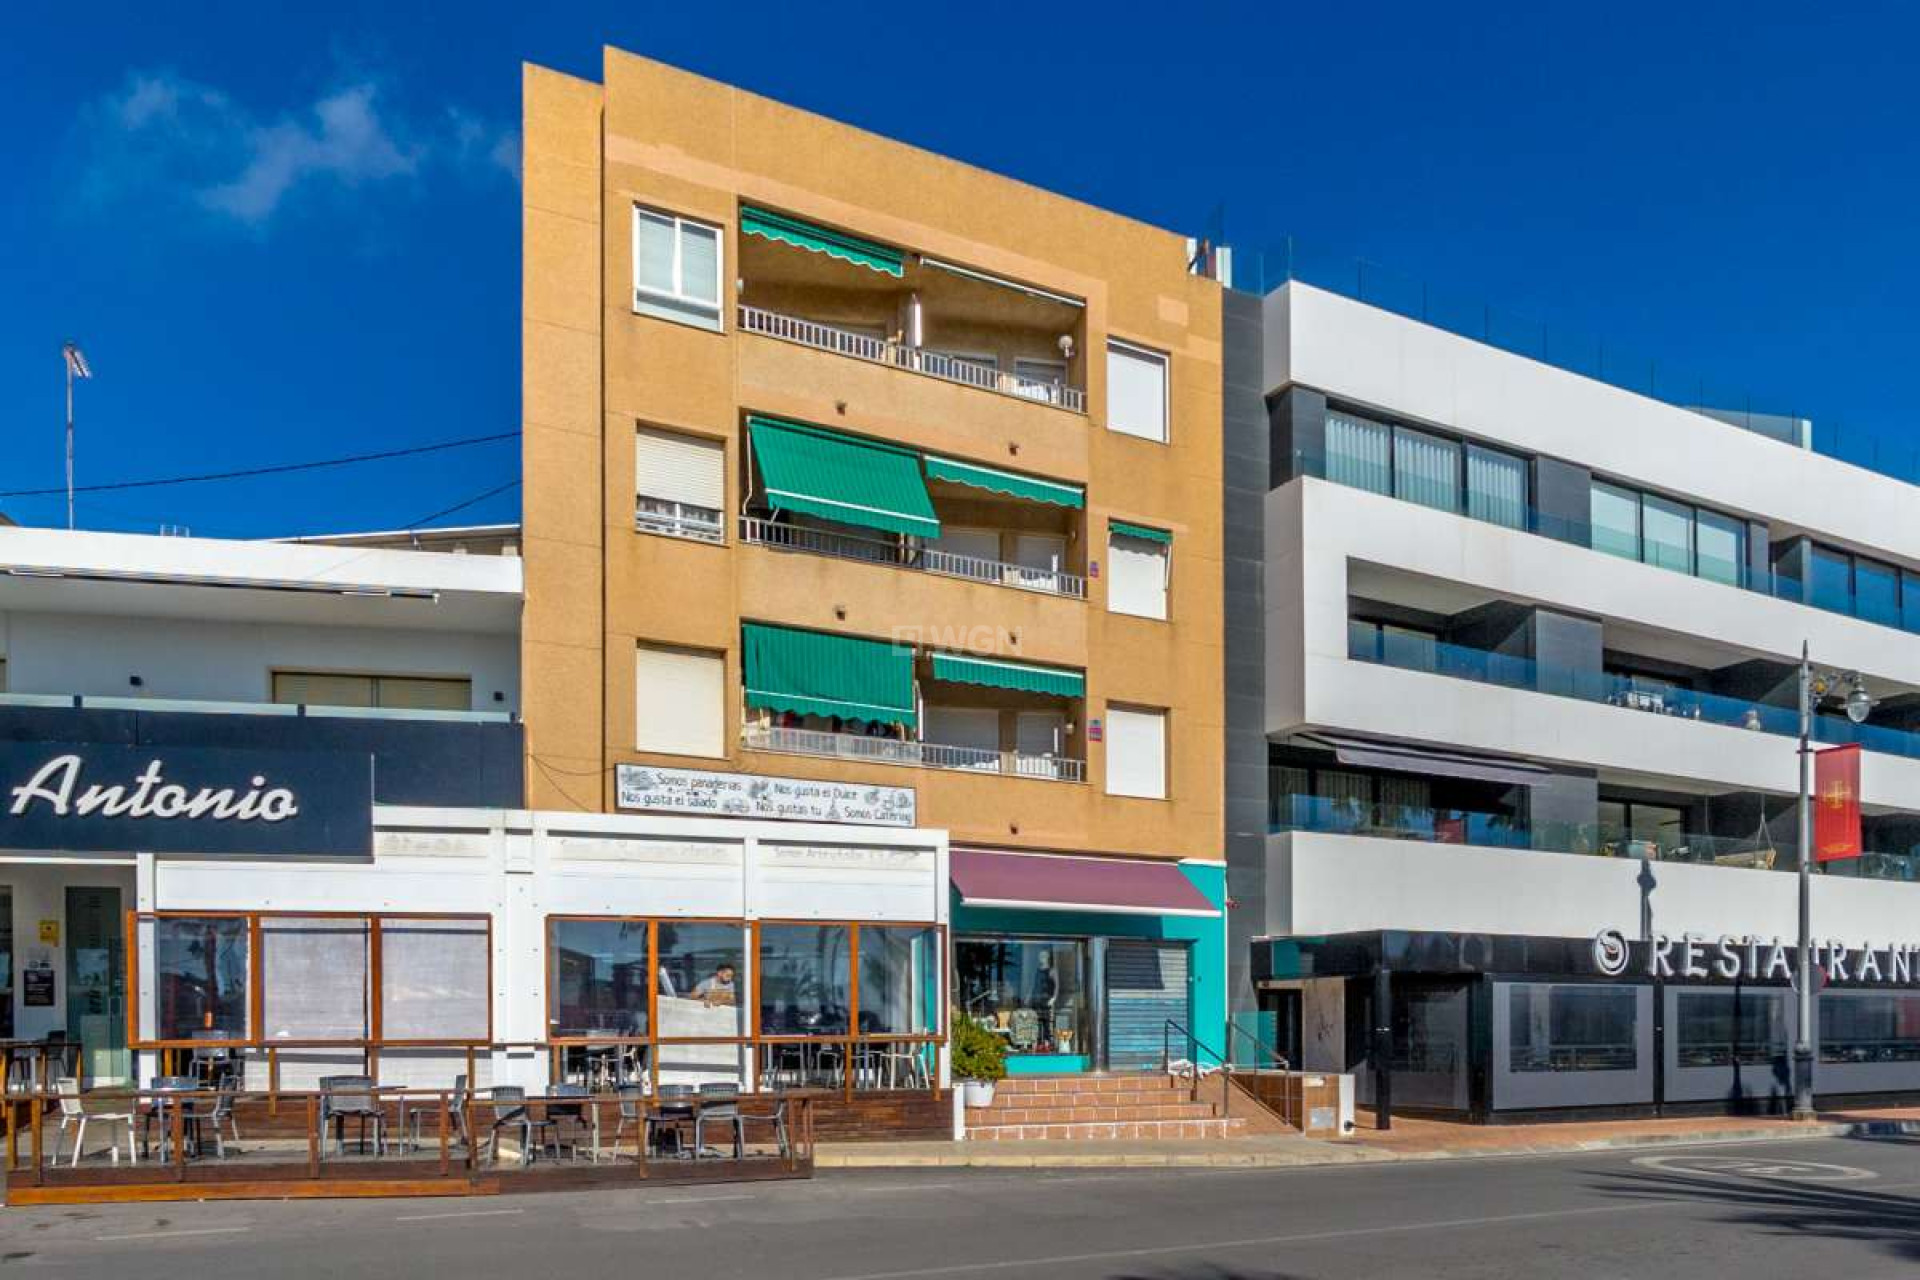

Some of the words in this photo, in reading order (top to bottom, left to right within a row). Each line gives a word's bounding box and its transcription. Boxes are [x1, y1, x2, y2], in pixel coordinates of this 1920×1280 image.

[657, 772, 687, 786] Somos
[10, 755, 297, 820] Antonio
[774, 783, 792, 794] Nos
[795, 786, 820, 798] gusta
[622, 791, 640, 802] Nos
[645, 795, 672, 806] gusta
[675, 795, 684, 805] el
[756, 801, 773, 812] Nos
[844, 806, 871, 819] Somos
[1649, 934, 1920, 983] RESTARAN
